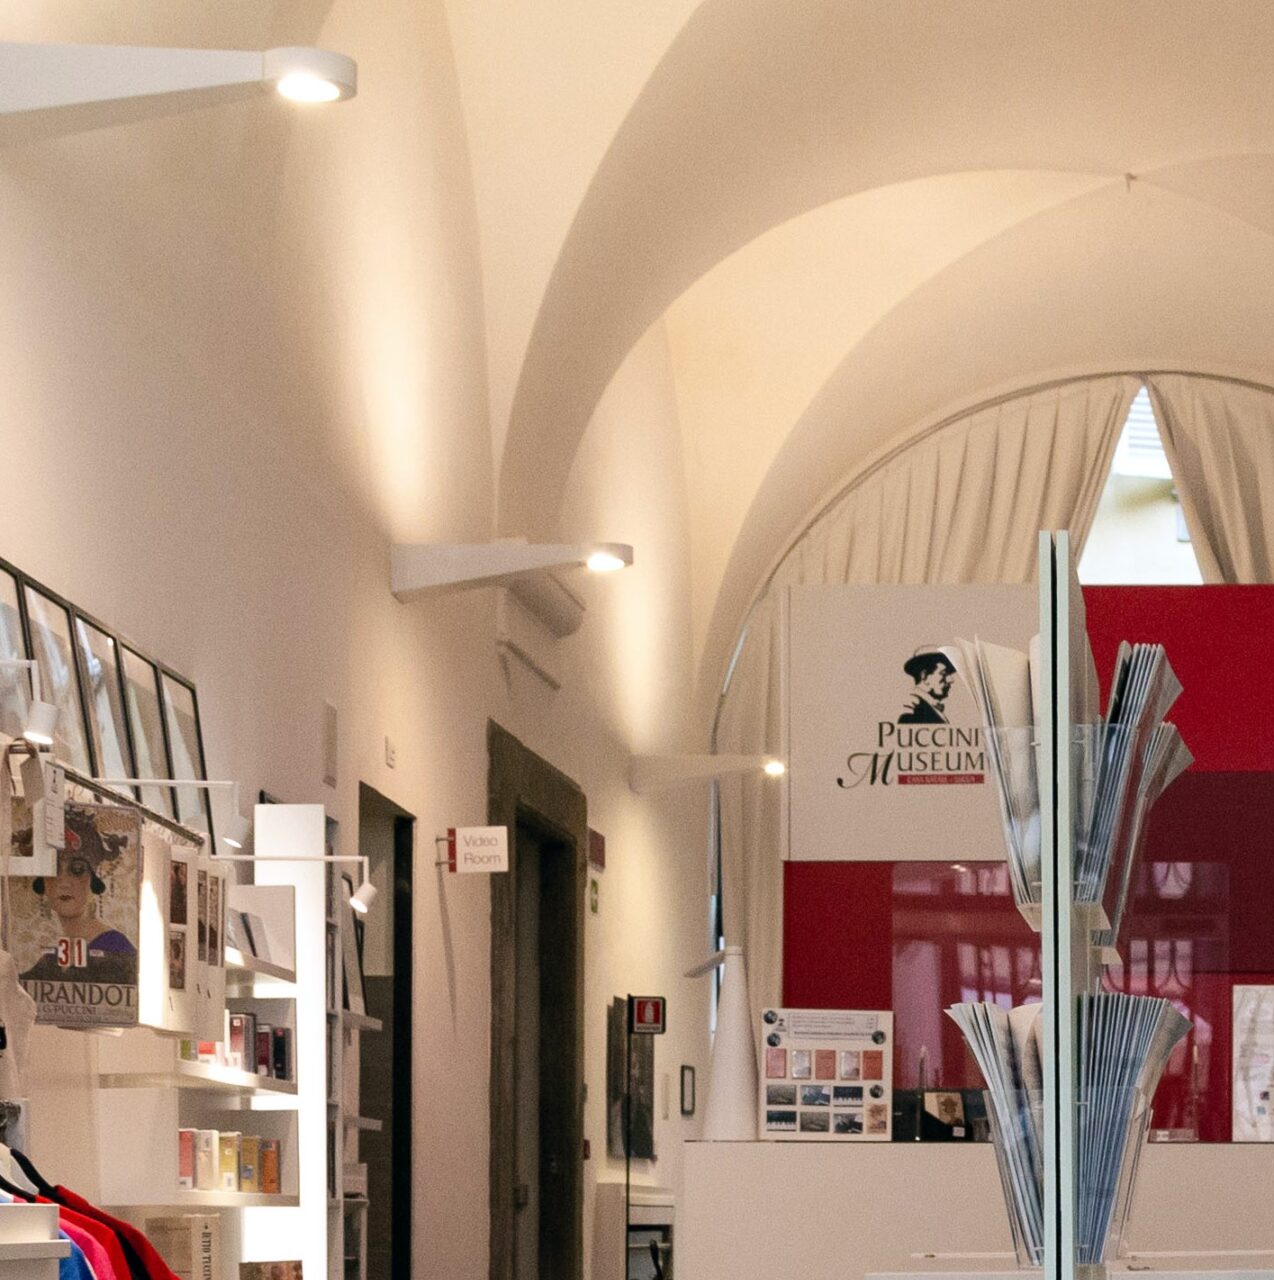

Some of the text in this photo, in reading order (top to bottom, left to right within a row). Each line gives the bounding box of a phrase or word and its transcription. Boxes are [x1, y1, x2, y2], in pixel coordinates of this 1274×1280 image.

[878, 721, 979, 748] PUCCINI
[836, 750, 985, 789] MUSEUM
[463, 835, 498, 847] Video
[463, 853, 500, 865] Room
[22, 980, 136, 1007] URANDOT
